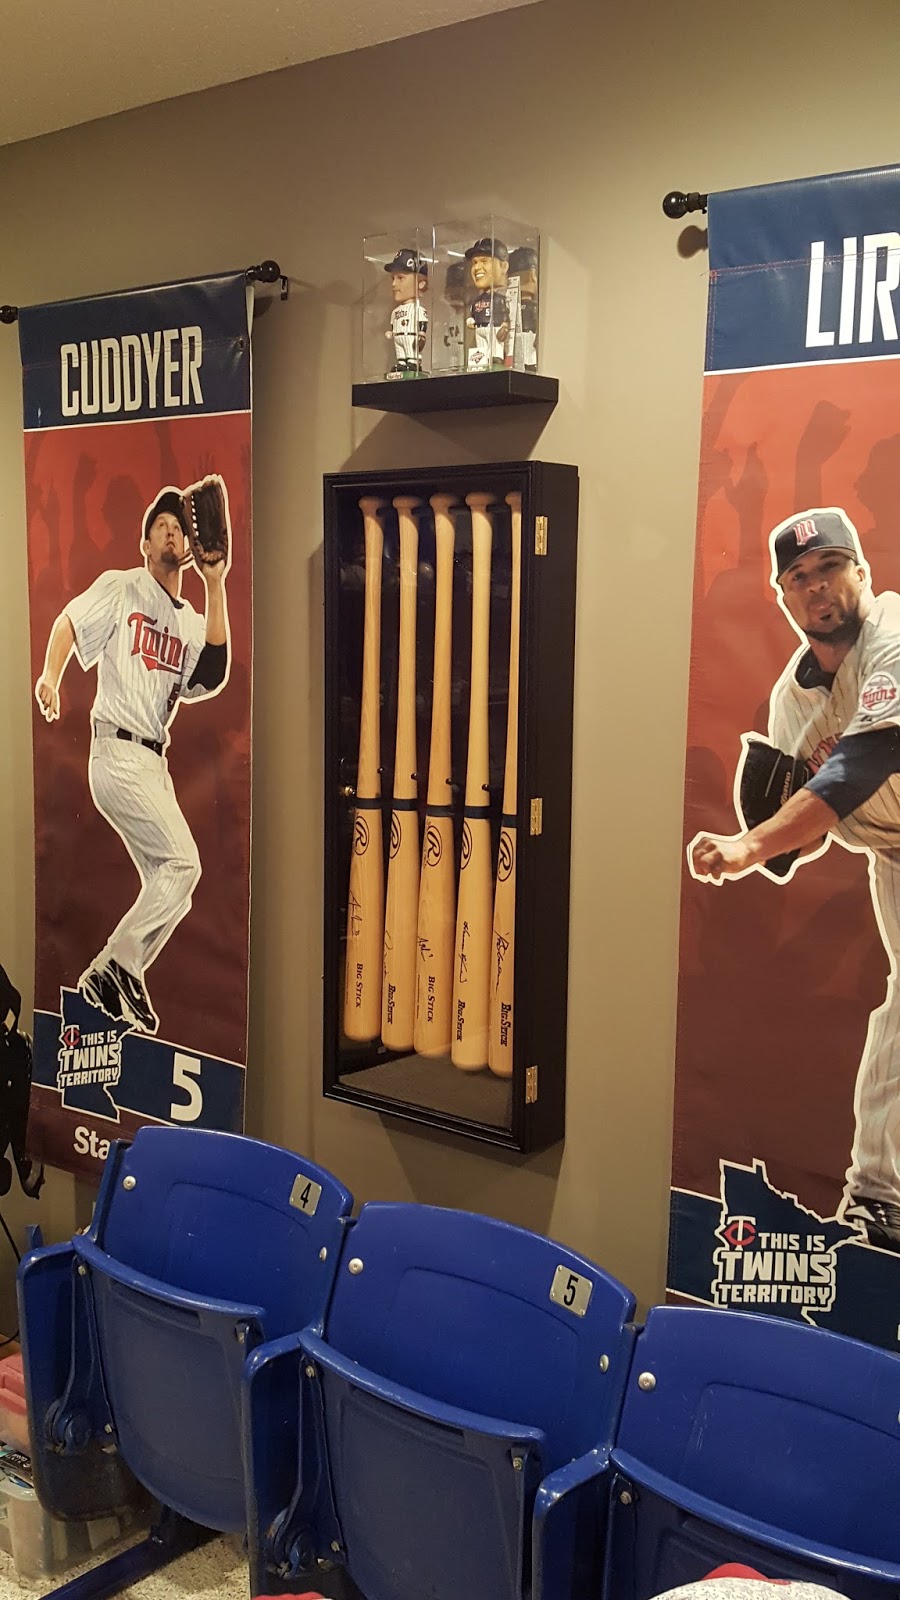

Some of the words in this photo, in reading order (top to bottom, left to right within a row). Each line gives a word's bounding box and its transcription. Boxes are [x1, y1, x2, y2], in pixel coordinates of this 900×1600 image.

[805, 231, 900, 348] LIR
[60, 325, 204, 417] CUDDYER
[80, 1031, 104, 1046] THIS
[106, 1029, 118, 1043] IS
[61, 1043, 119, 1071] TWINS
[60, 1066, 118, 1087] TERRITORY
[170, 1051, 203, 1121] 5
[299, 1181, 312, 1209] 4
[758, 1232, 800, 1250] THIS
[806, 1234, 826, 1252] IS
[720, 1251, 832, 1283] TWINS
[562, 1274, 579, 1306] 5
[718, 1284, 831, 1305] TERRITORY
